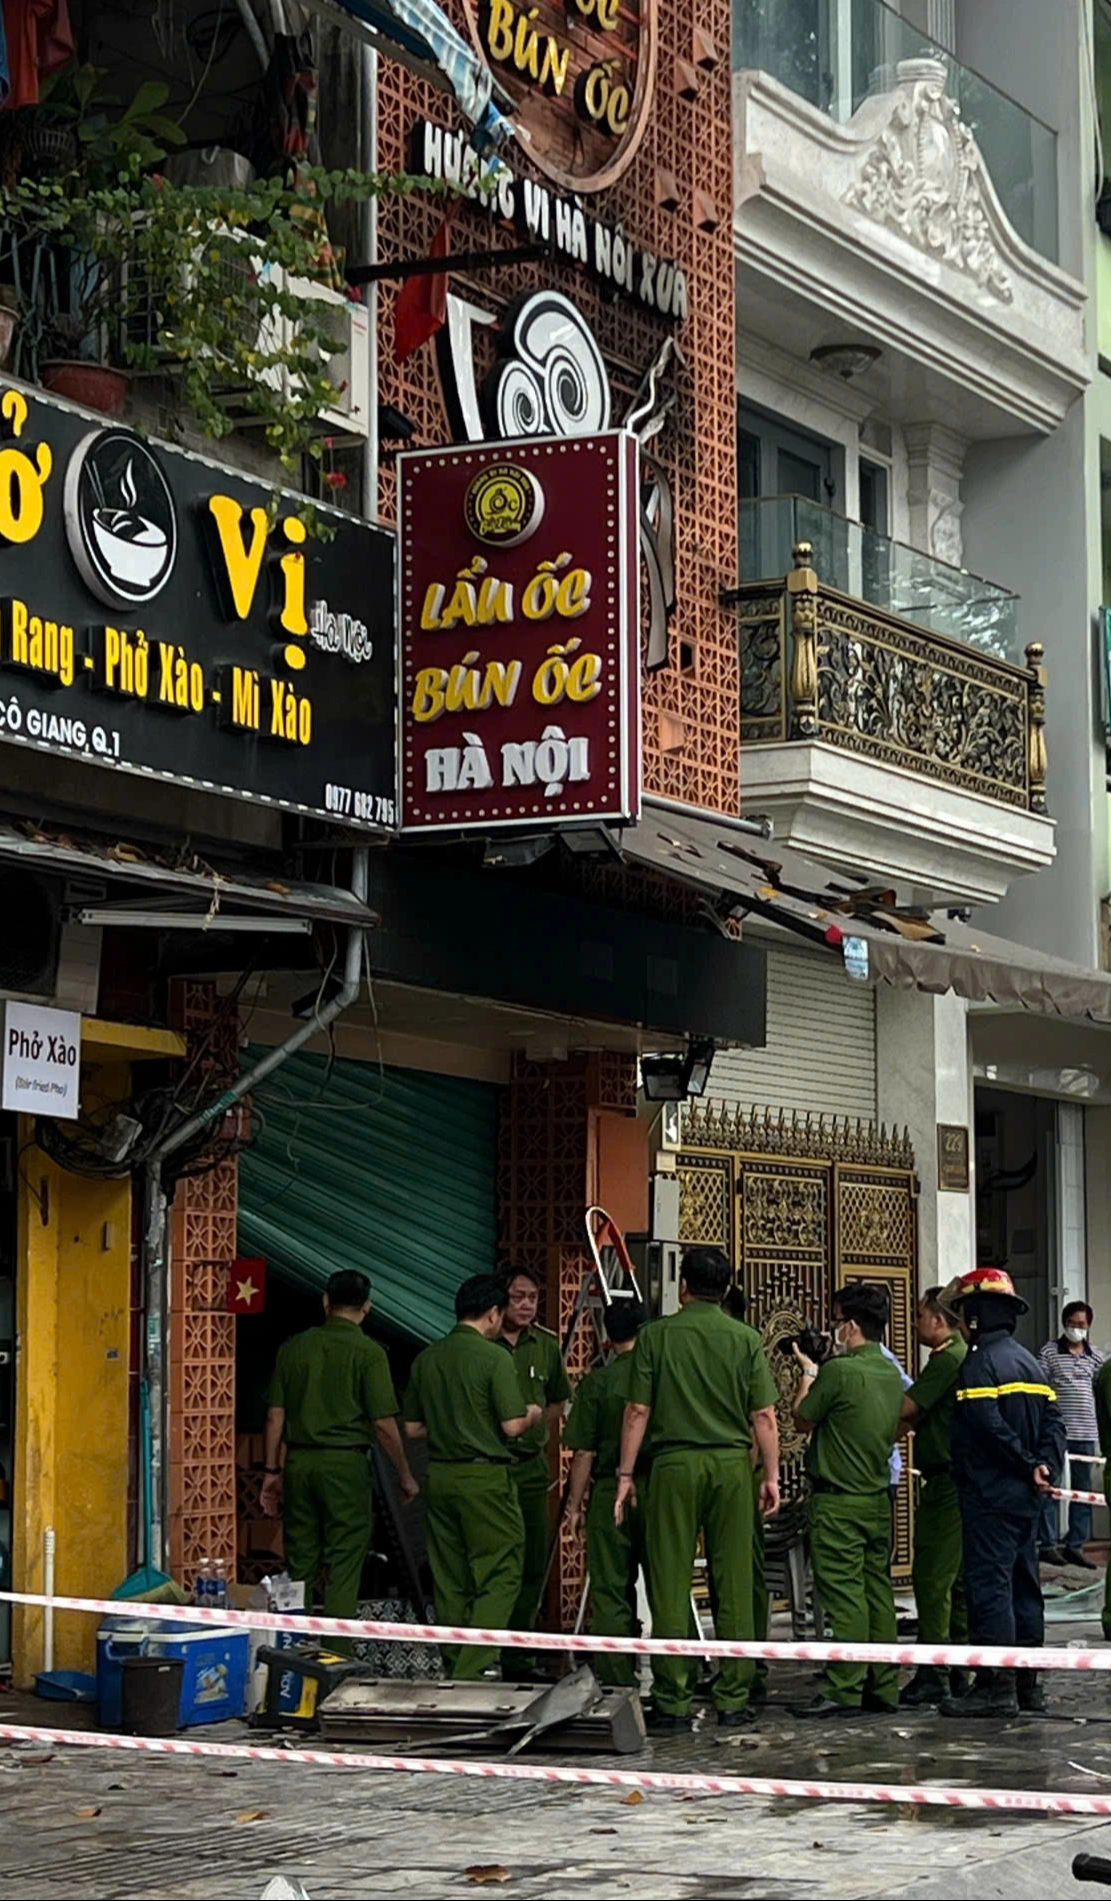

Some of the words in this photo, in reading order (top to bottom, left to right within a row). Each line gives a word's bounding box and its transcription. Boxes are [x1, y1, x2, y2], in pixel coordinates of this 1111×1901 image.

[488, 0, 569, 96] BÚN
[585, 60, 629, 135] ỐC
[556, 194, 588, 263] HÀ
[209, 494, 308, 670] Vị
[522, 552, 592, 620] ỐC
[12, 599, 74, 687] Rang
[105, 626, 148, 697] Phở
[159, 641, 204, 711] Xào
[233, 666, 260, 730] Mì
[271, 678, 312, 745] Xào
[412, 650, 522, 722] BÚN
[532, 637, 602, 705] ỐC
[92, 726, 120, 757] Q.1
[424, 731, 494, 792] HÀ
[501, 725, 591, 797] NỘI
[8, 1028, 43, 1061] Phở
[46, 1034, 77, 1067] Xào
